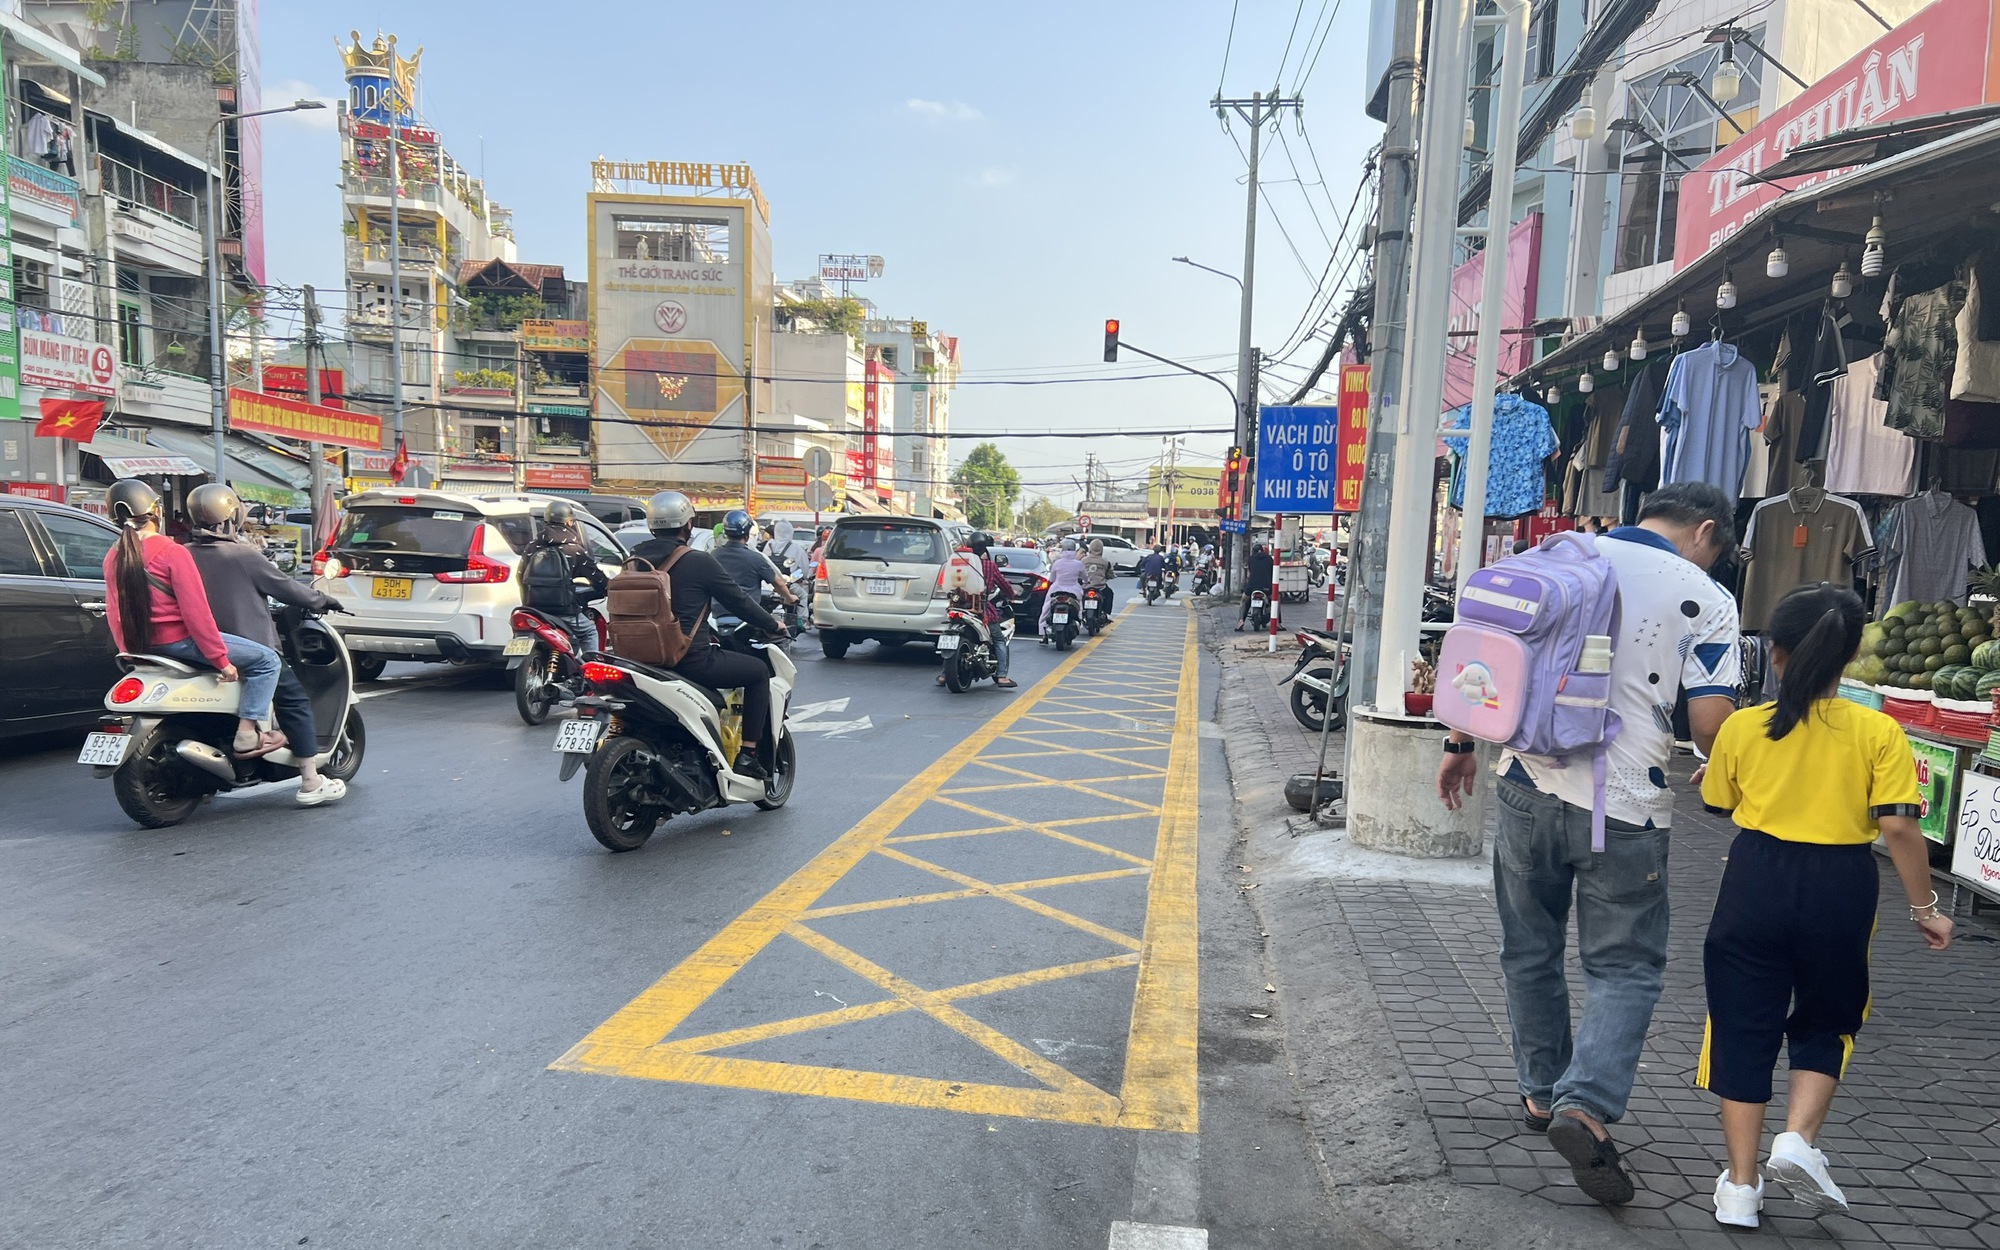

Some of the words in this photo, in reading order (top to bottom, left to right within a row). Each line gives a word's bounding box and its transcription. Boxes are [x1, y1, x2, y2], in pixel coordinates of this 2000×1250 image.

[648, 161, 711, 187] MINH
[619, 263, 637, 278] THẾ
[640, 265, 660, 279] GIỚI
[663, 269, 698, 280] TRANG
[701, 268, 722, 281] SỨC
[912, 322, 926, 334] 58
[97, 350, 108, 370] 6
[1346, 371, 1363, 392] VINH
[1352, 408, 1360, 428] 80
[1267, 425, 1307, 448] VẠCH
[364, 457, 393, 470] KIM
[1292, 449, 1303, 471] Ô
[1309, 449, 1328, 471] TÔ
[1191, 488, 1214, 496] 0938
[1264, 480, 1291, 498] KHI
[1296, 475, 1329, 499] ĐÈN
[1343, 475, 1358, 504] VIỆT
[376, 589, 406, 598] 431.35
[565, 722, 592, 736] 65-F1
[92, 735, 121, 749] 83-P4
[556, 737, 592, 751] 478.26
[82, 748, 121, 765] 521.64
[1960, 789, 1980, 841] Ép
